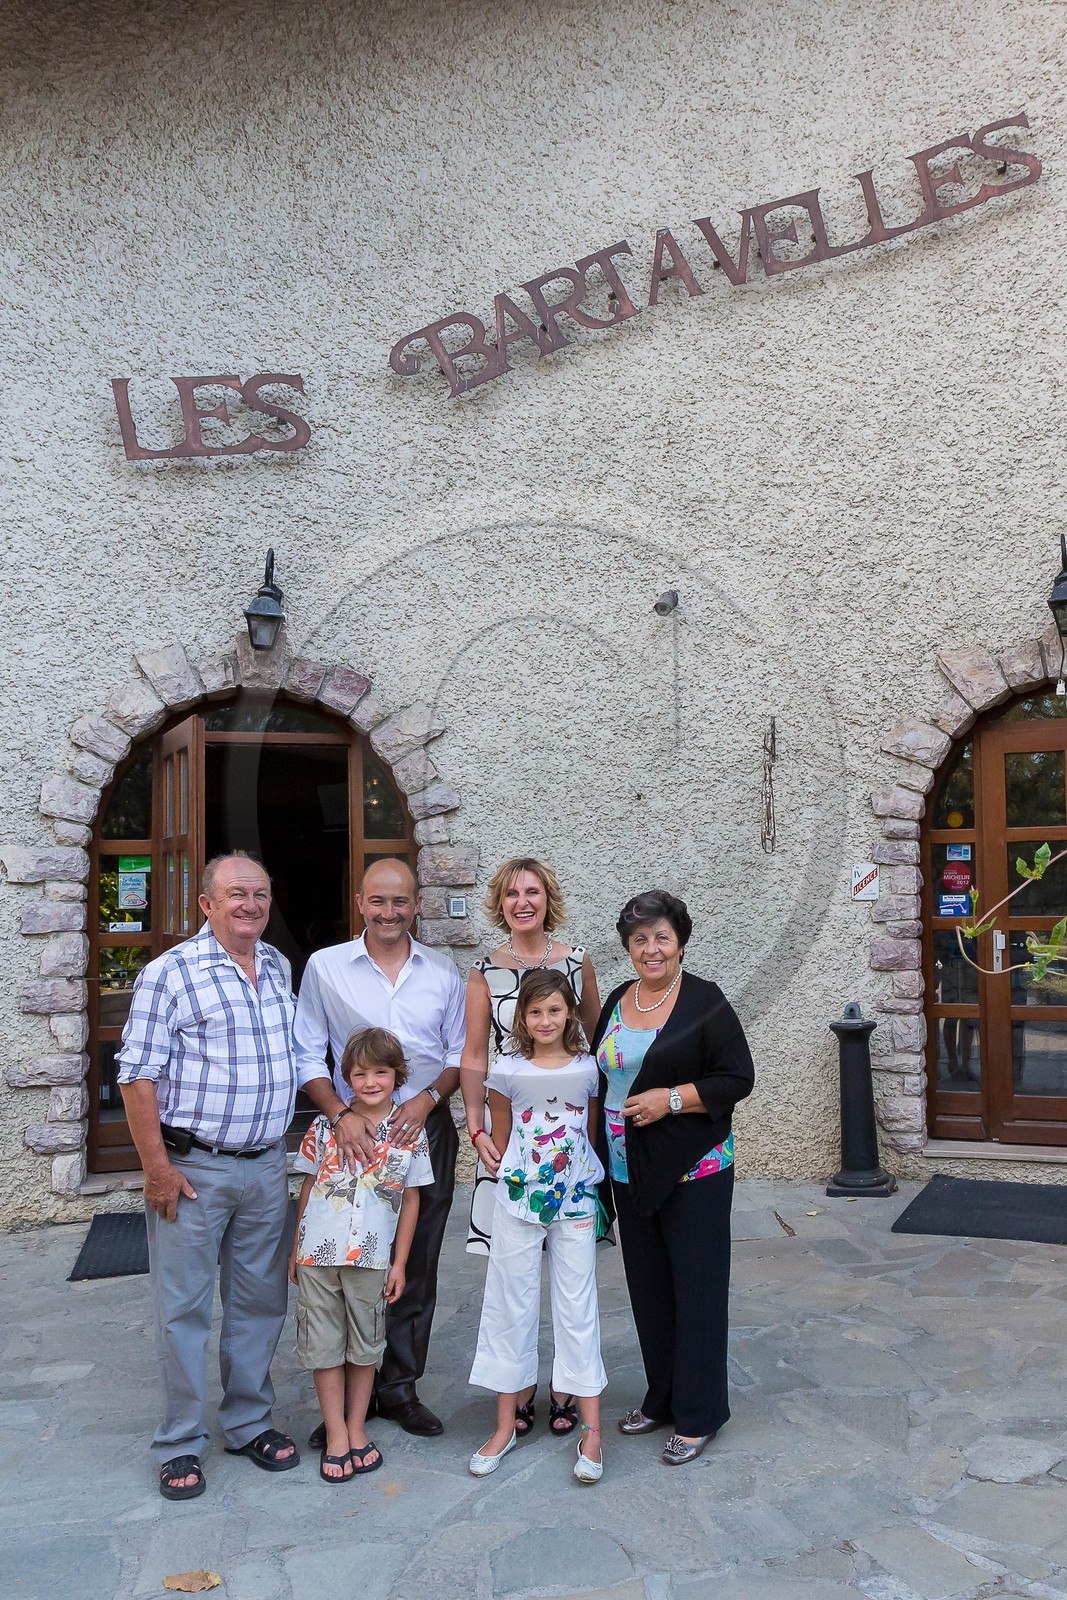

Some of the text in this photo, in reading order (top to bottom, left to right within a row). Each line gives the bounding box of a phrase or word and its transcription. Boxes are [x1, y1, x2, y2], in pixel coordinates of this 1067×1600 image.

[111, 111, 1042, 460] LES BARTAVELLES
[854, 870, 863, 878] IV
[854, 869, 878, 895] LICENCE
